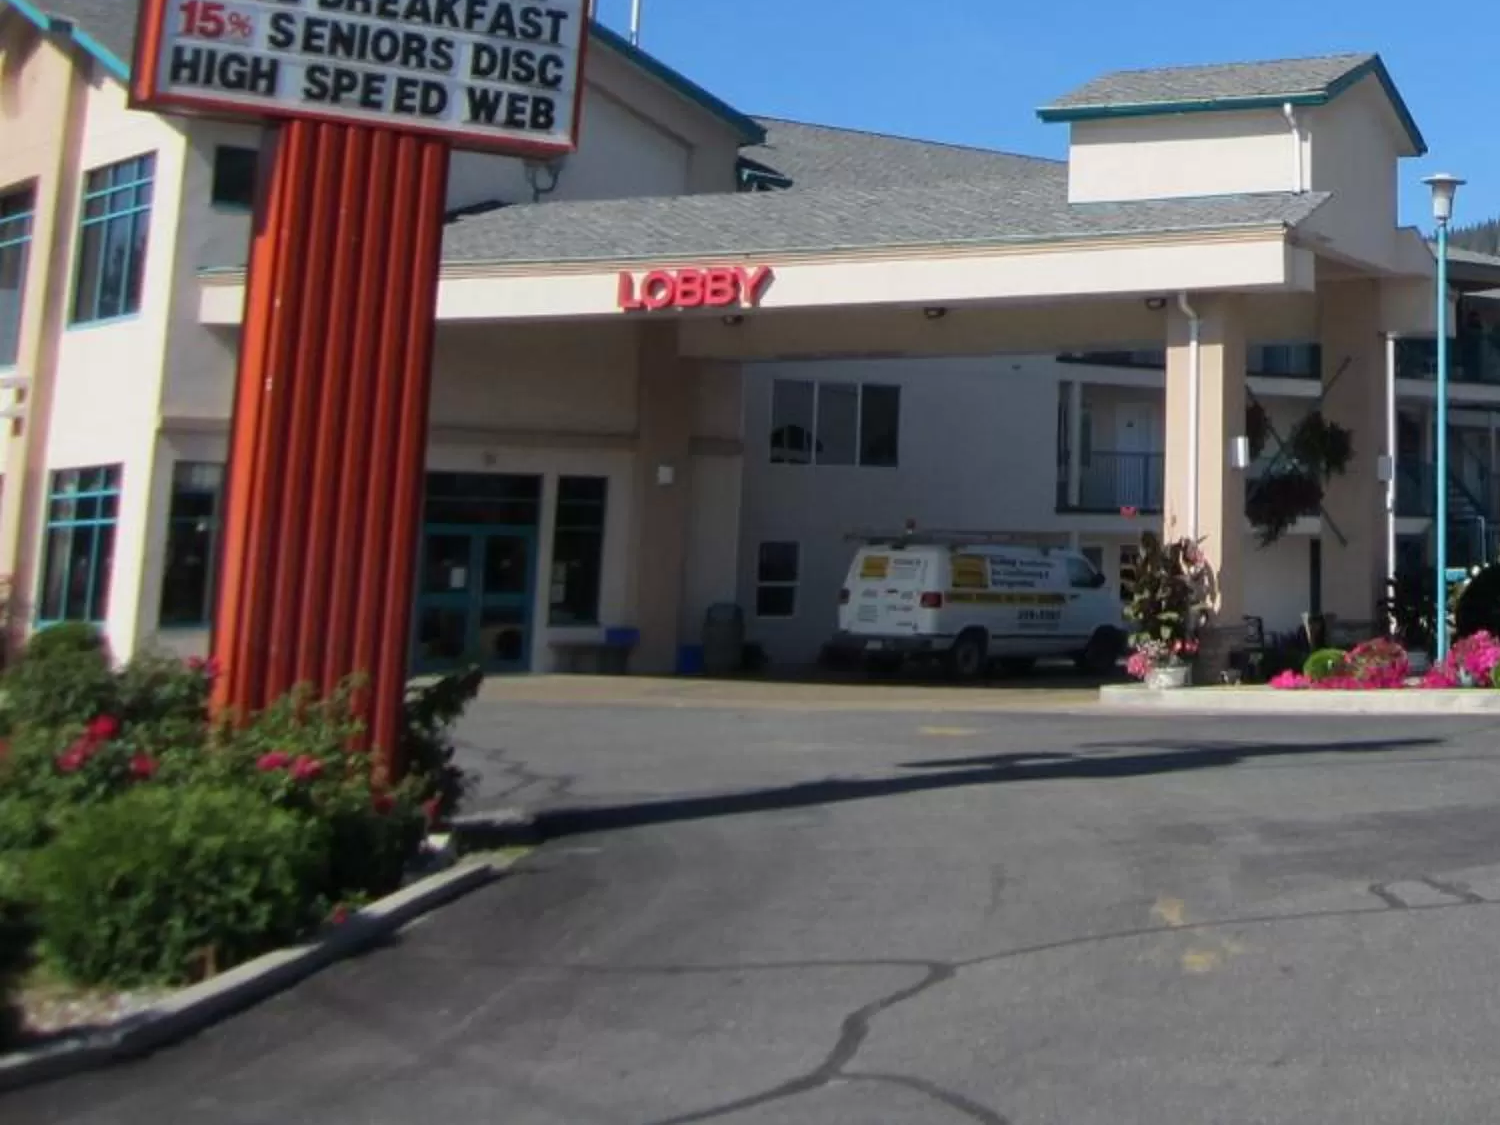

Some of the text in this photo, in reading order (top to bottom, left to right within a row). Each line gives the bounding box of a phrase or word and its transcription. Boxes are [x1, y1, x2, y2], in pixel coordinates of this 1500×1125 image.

[179, 1, 563, 88] 15% SENIORS DISC
[168, 46, 555, 131] HIGH SPEED WEB
[617, 265, 775, 312] LOBBY
